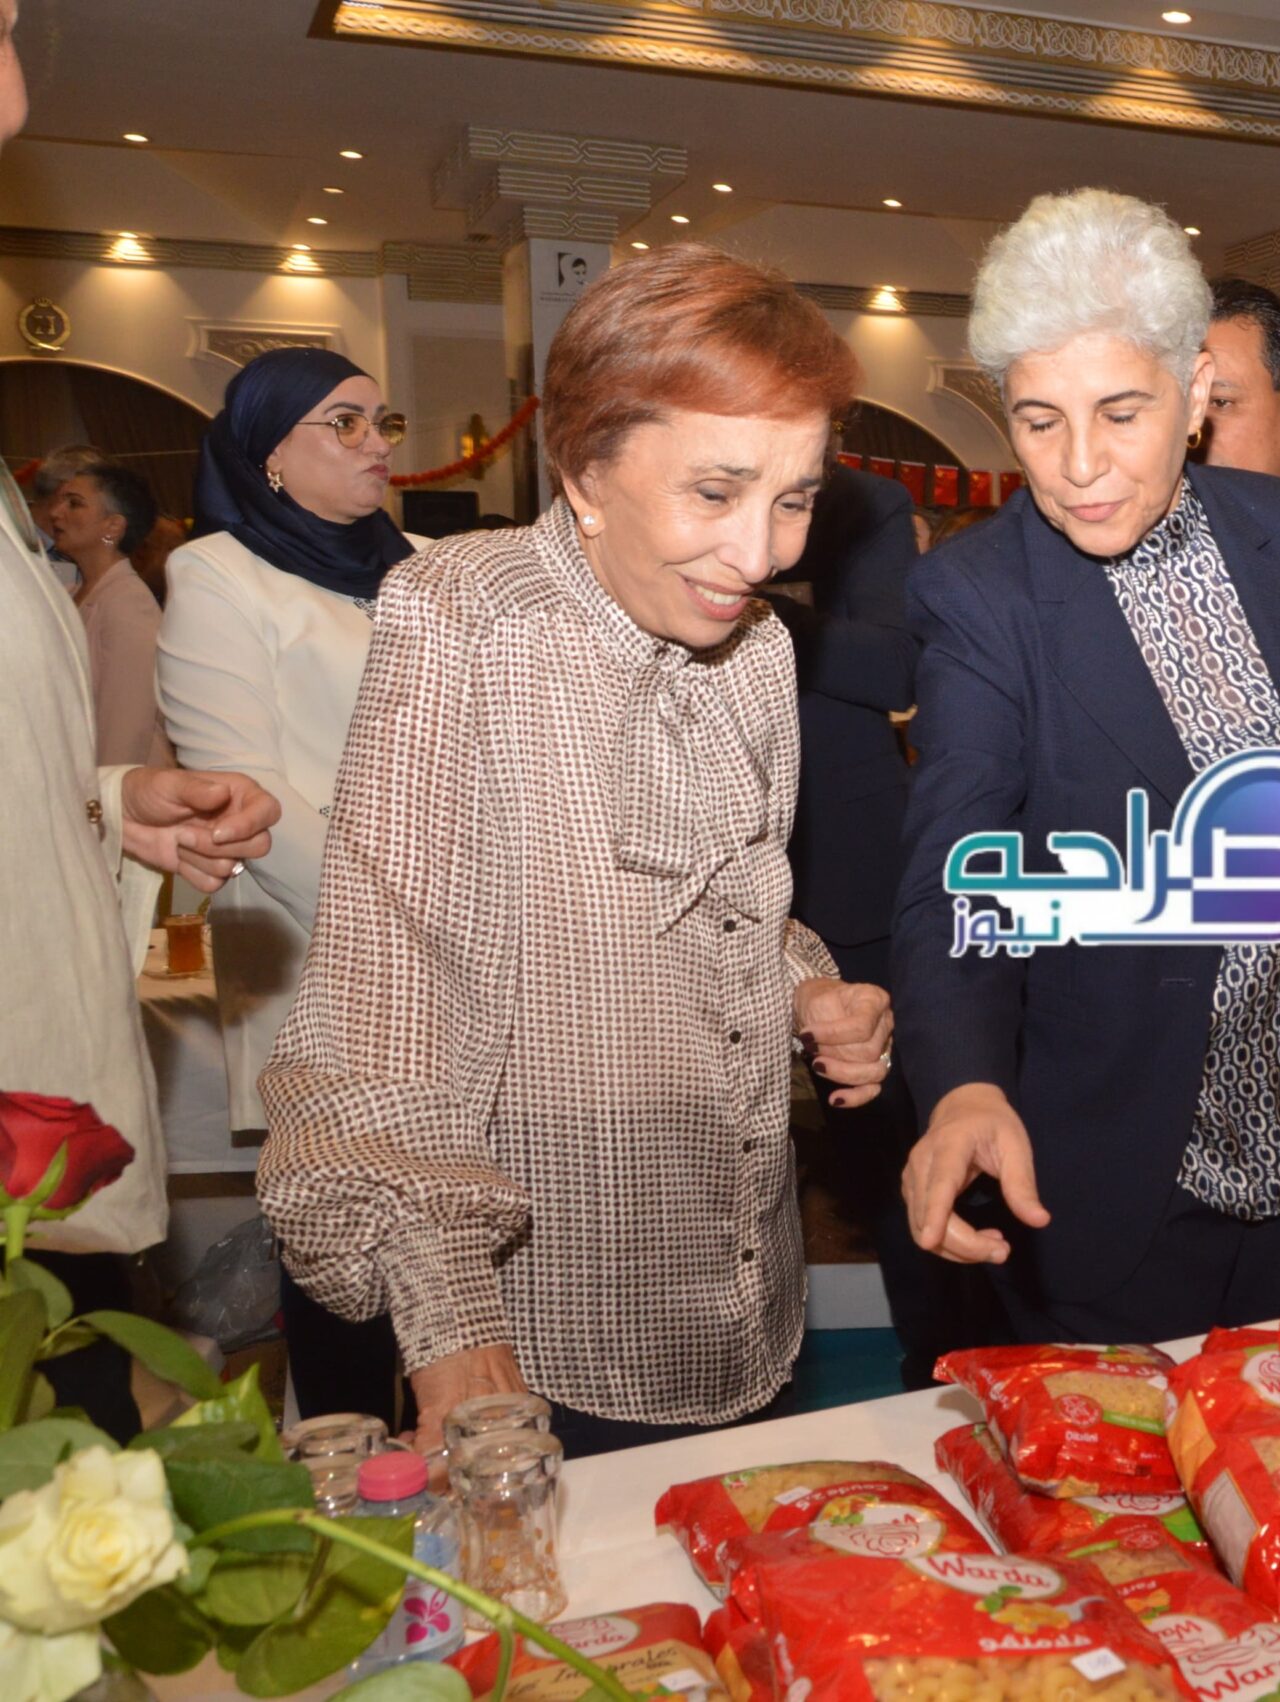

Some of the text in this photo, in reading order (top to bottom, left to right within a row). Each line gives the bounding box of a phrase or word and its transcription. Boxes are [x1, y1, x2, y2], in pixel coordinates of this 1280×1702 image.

[925, 1554, 1050, 1588] Warda
[560, 1631, 629, 1650] arda
[1154, 1619, 1203, 1641] War
